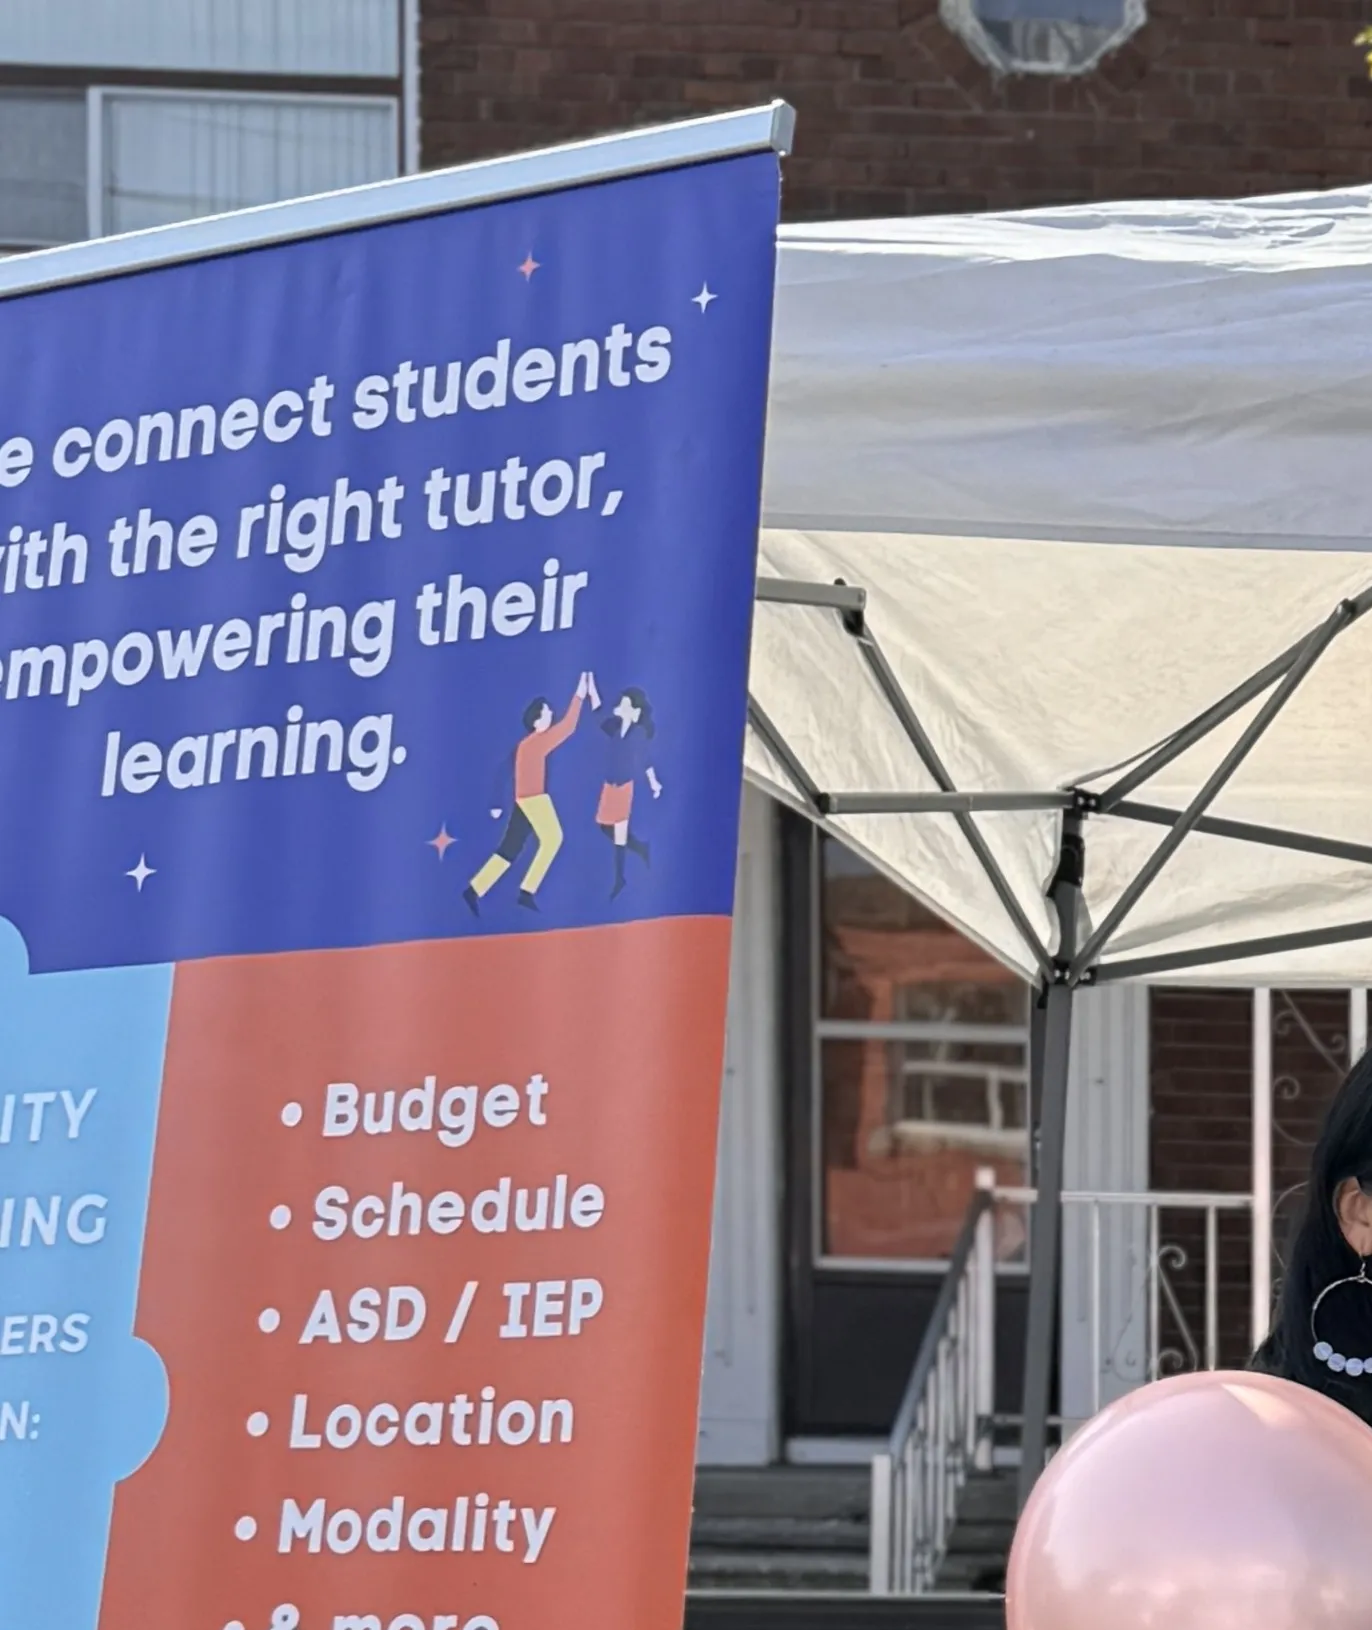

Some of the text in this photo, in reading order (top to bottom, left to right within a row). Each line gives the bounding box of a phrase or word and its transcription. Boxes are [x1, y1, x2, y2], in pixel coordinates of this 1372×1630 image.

[0, 323, 672, 488] e connect students
[0, 451, 624, 594] ith the right tutor,
[0, 558, 588, 707] mpowering their
[102, 705, 407, 796] learning.
[0, 1087, 98, 1143] ITY
[322, 1074, 549, 1147] Budget
[0, 1193, 108, 1248] ING
[312, 1175, 605, 1241] Schedule
[0, 1312, 91, 1355] ERS
[299, 1278, 604, 1345] ASD / IEP
[0, 1400, 40, 1441] N:
[289, 1386, 575, 1450] Location
[278, 1494, 556, 1563] Modality
